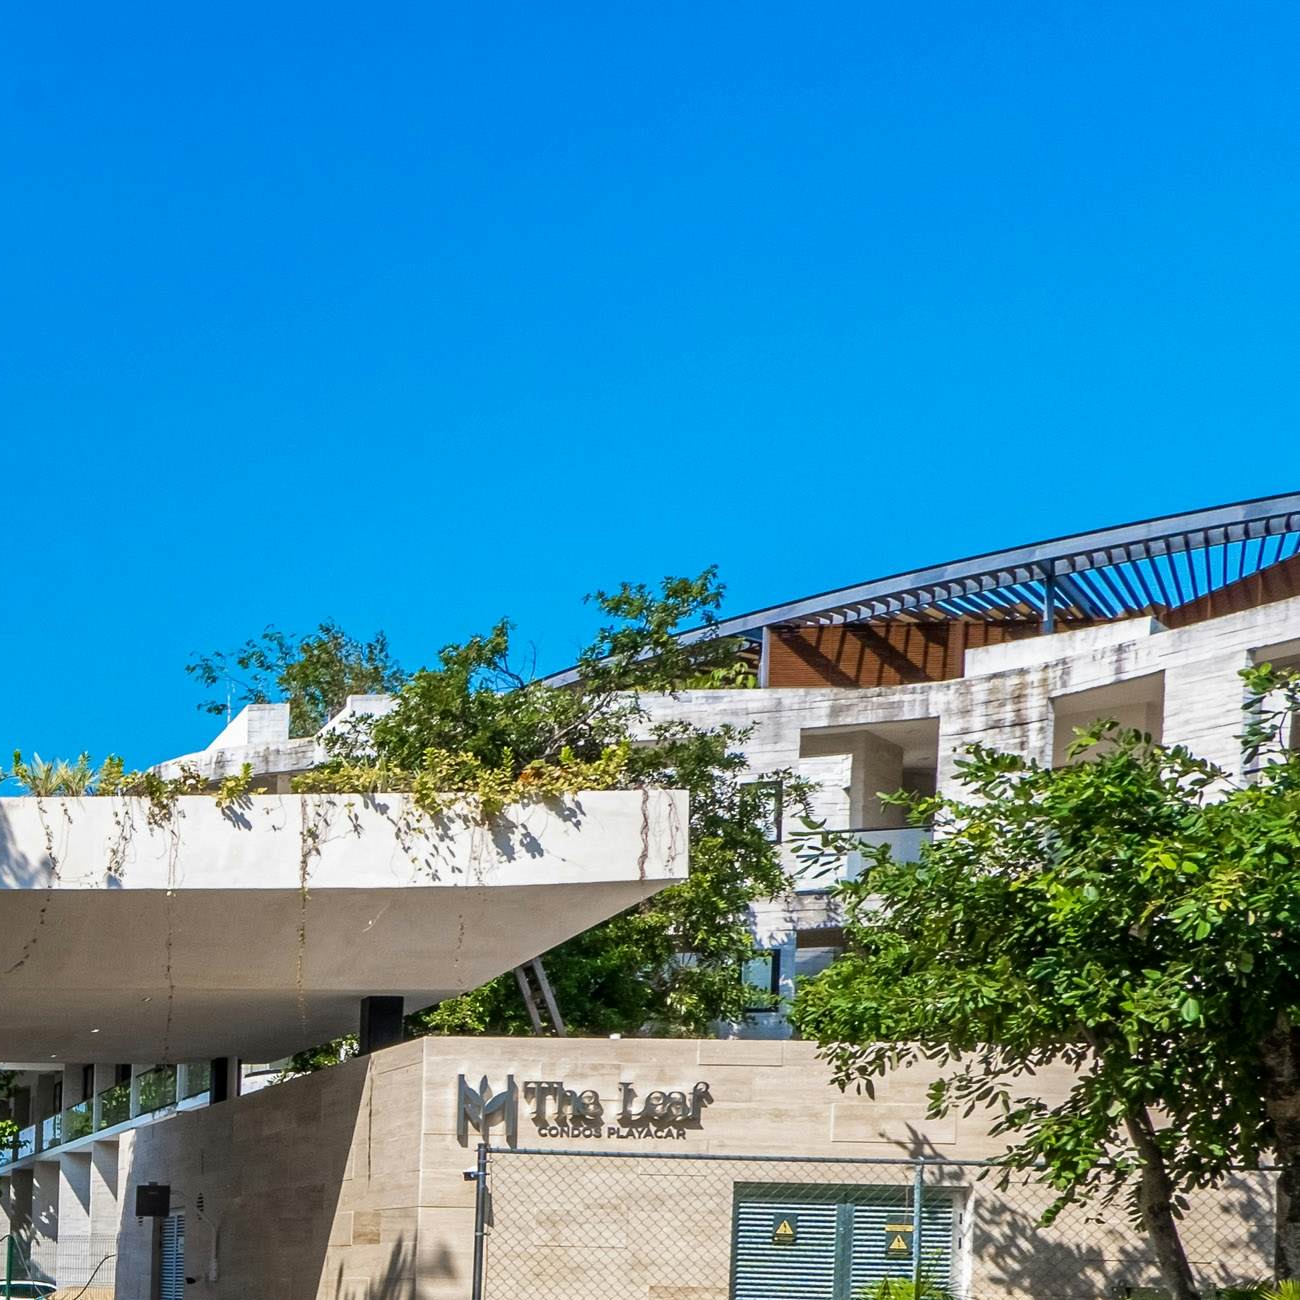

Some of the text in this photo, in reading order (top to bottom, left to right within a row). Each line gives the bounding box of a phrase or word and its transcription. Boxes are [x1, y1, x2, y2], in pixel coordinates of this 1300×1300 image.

[522, 1081, 714, 1130] The Leaf
[538, 1126, 687, 1140] CONDOS PLAYACAR
